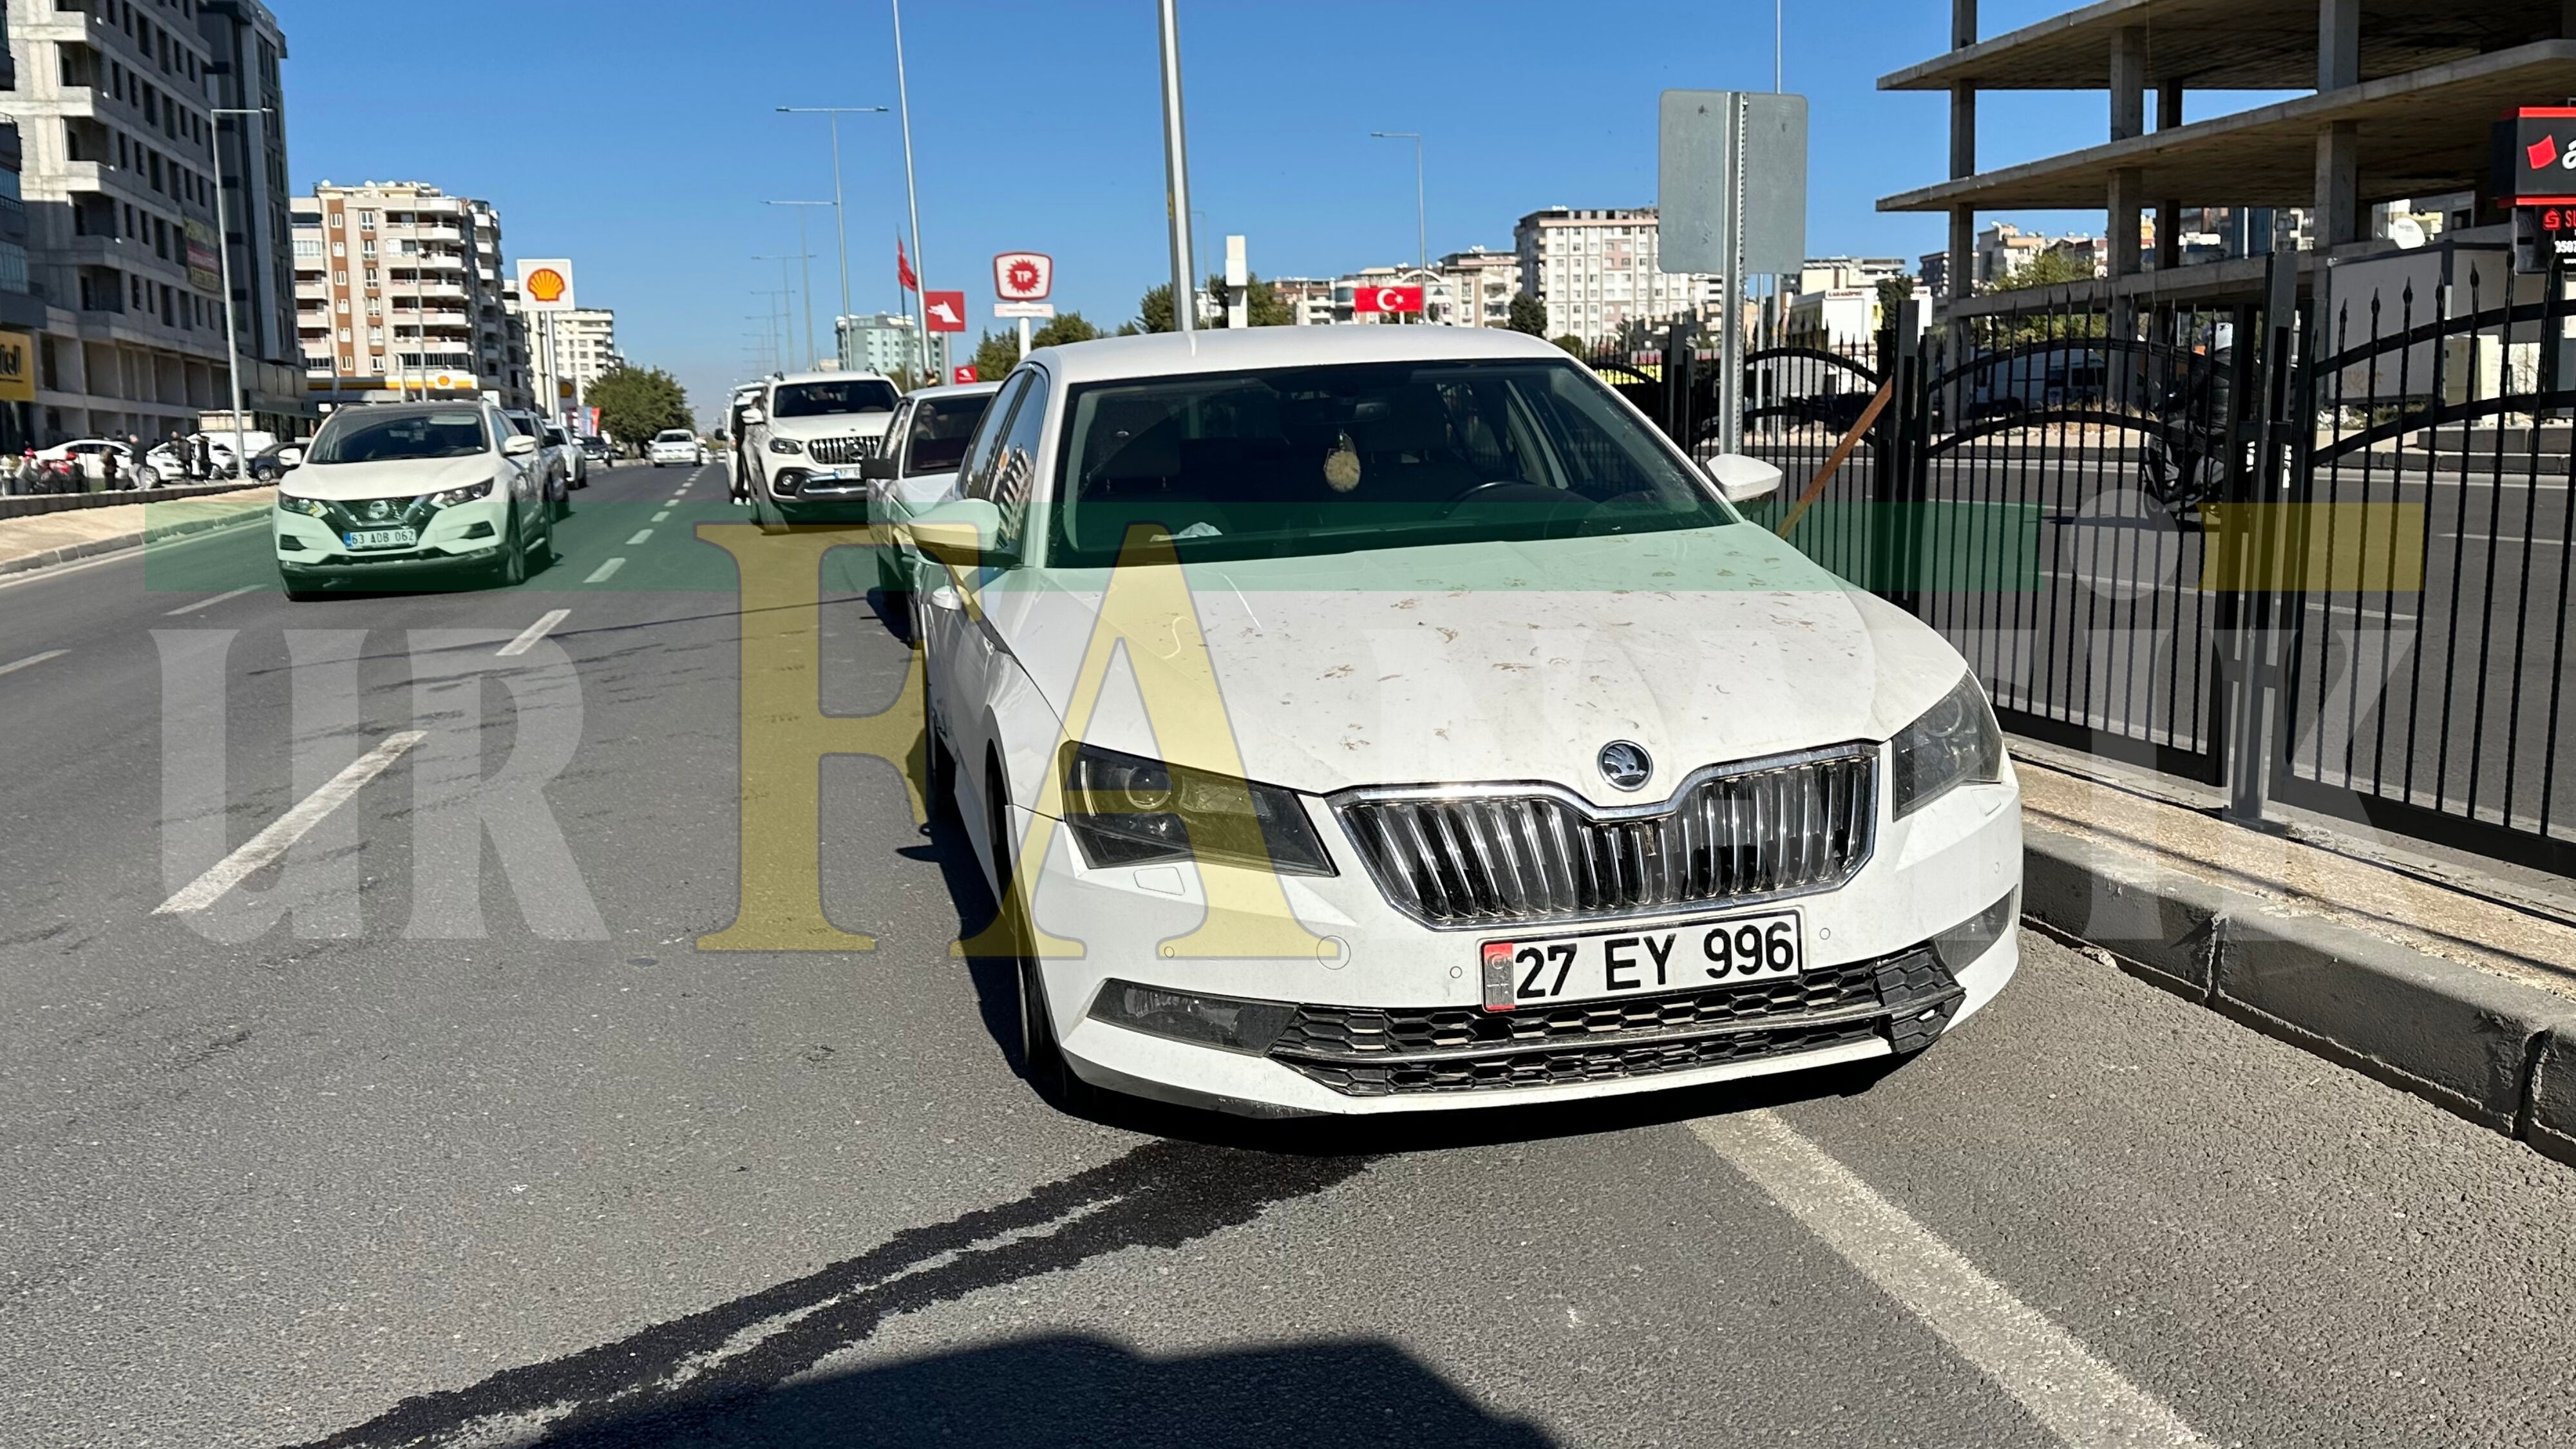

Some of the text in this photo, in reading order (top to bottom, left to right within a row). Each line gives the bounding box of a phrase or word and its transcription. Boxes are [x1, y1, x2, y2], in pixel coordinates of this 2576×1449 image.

[1015, 270, 1033, 283] TP
[352, 534, 365, 544] 63
[395, 531, 414, 542] 062
[1515, 921, 1794, 999] 27 EY 996
